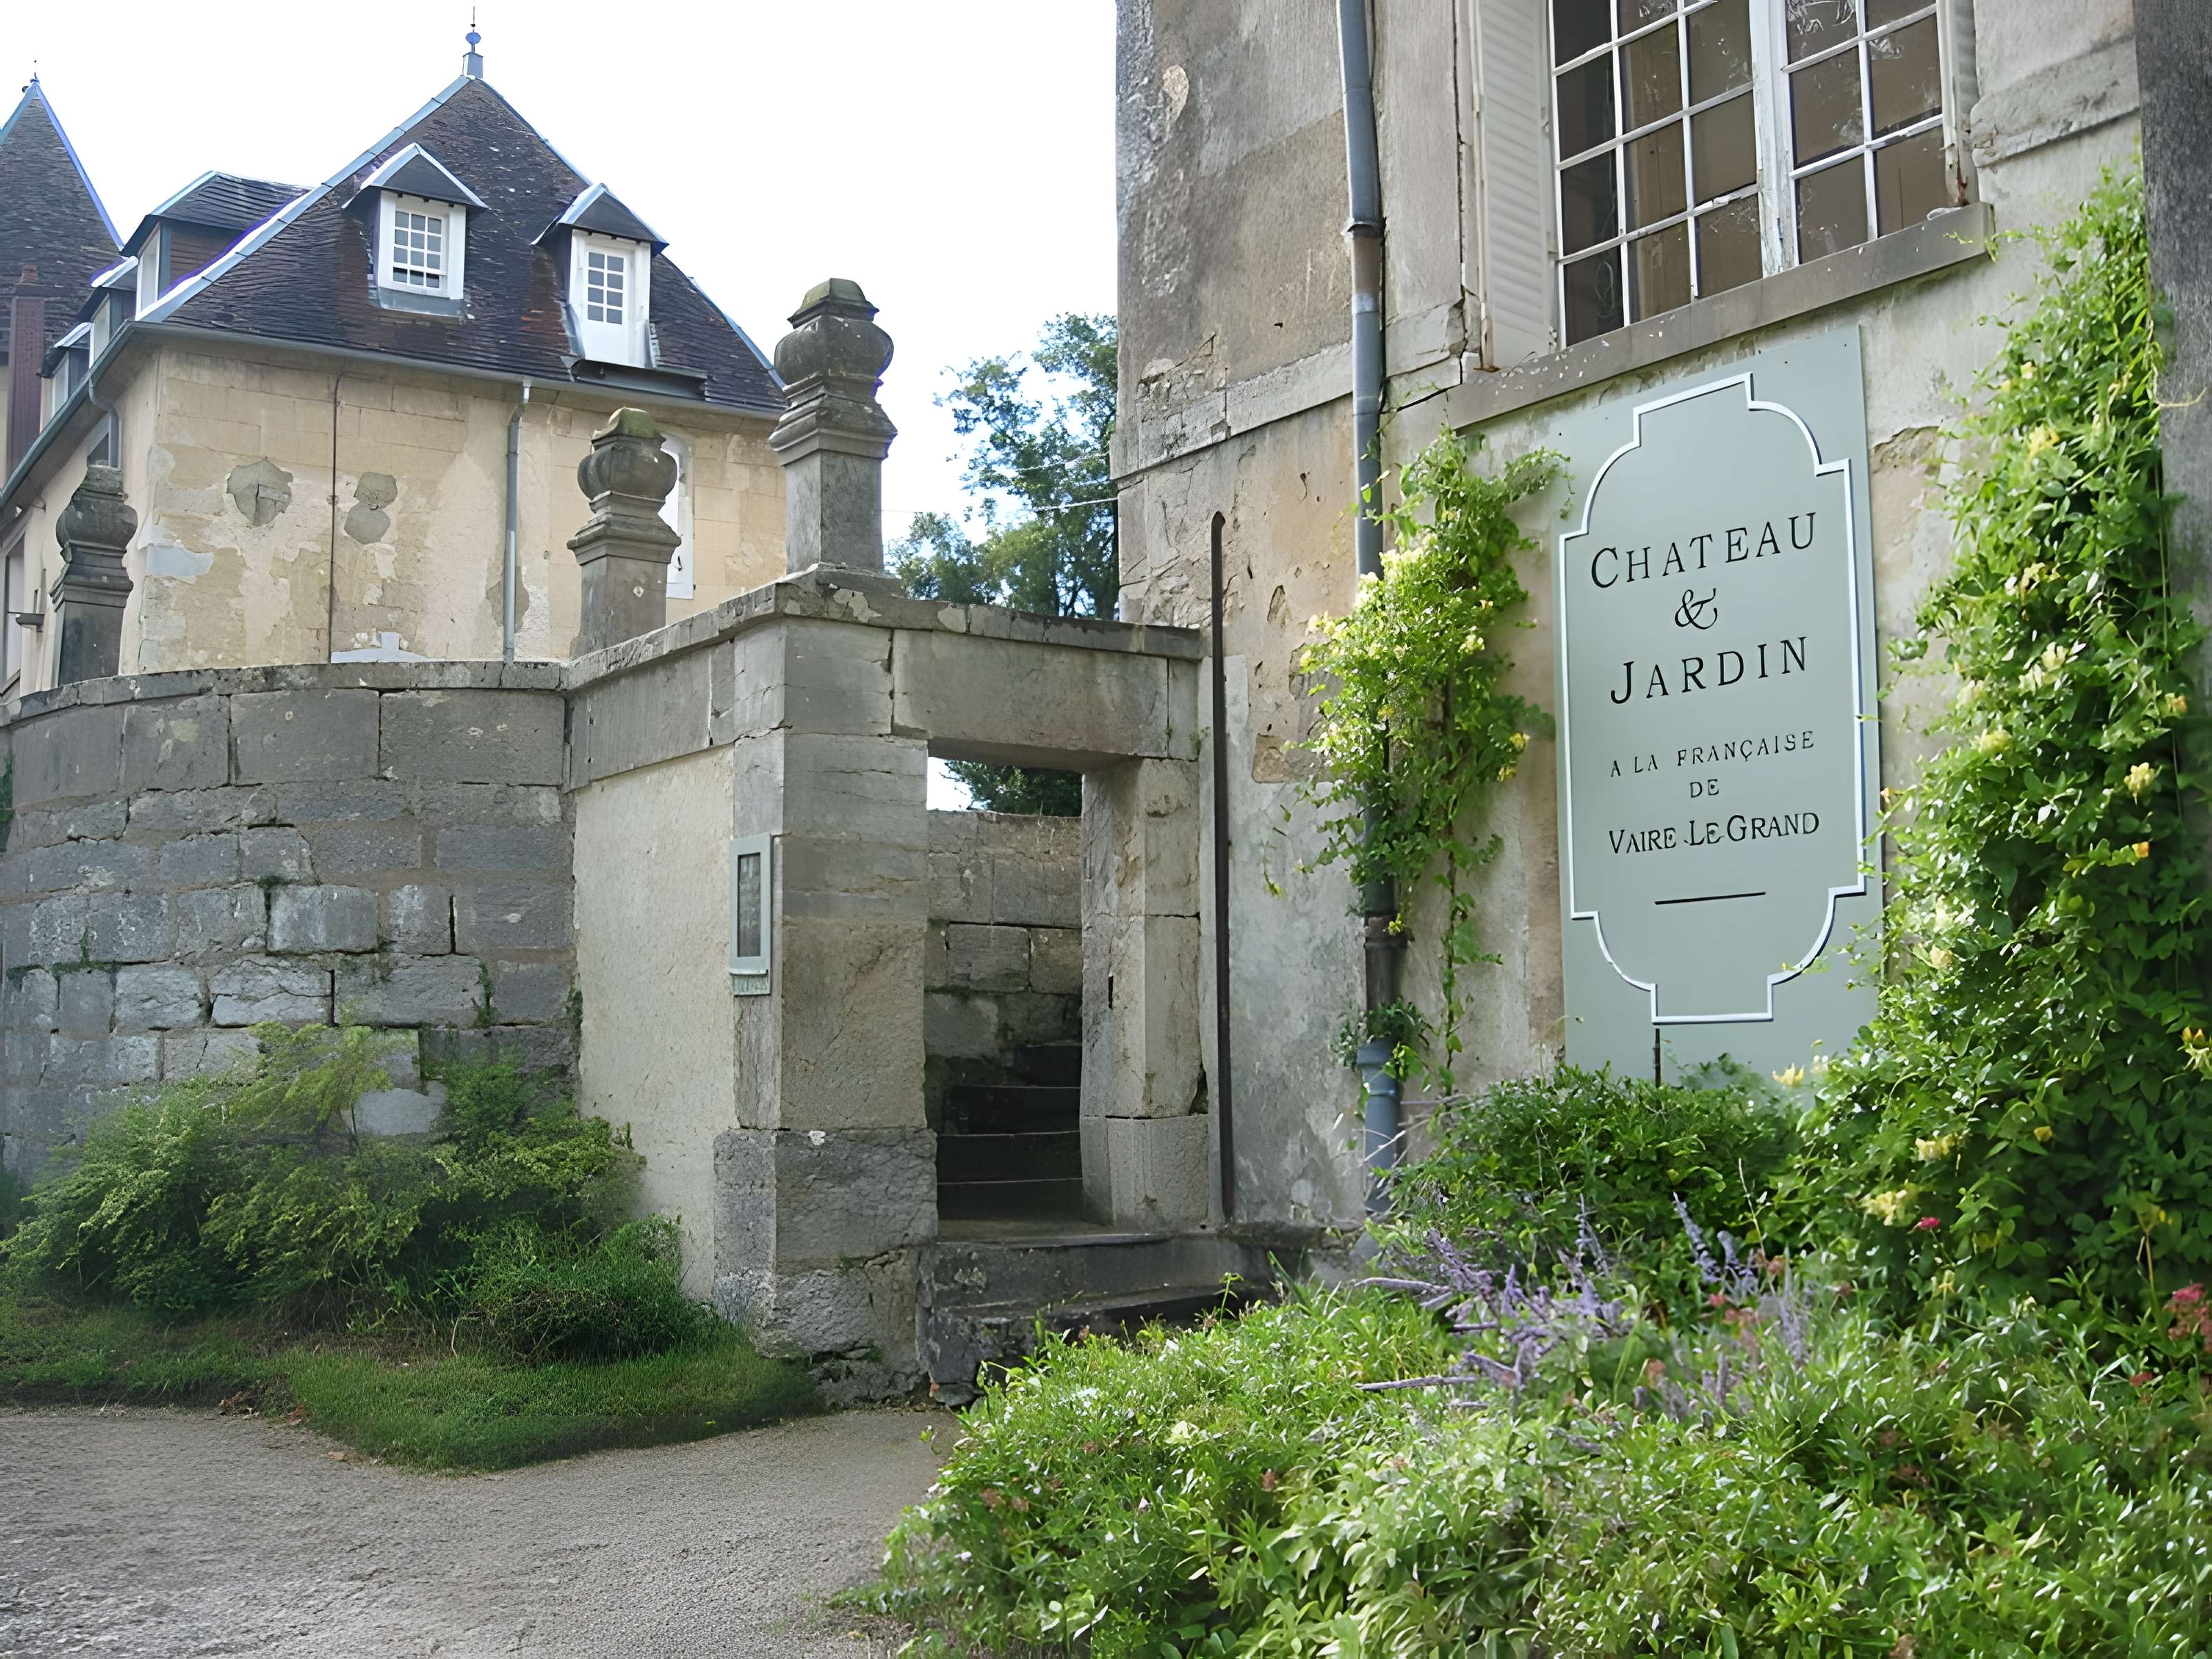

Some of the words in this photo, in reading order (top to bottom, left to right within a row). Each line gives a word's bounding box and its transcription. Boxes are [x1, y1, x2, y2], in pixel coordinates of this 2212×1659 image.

[1591, 512, 1817, 588] CHATEAU
[1674, 588, 1718, 630] &
[1610, 636, 1808, 704] JARDIN
[1610, 760, 1621, 778] A
[1634, 754, 1658, 774] LA
[1677, 731, 1814, 767] FRANÇAISE
[1689, 778, 1720, 798] DE
[1609, 827, 1676, 854] VAIRE
